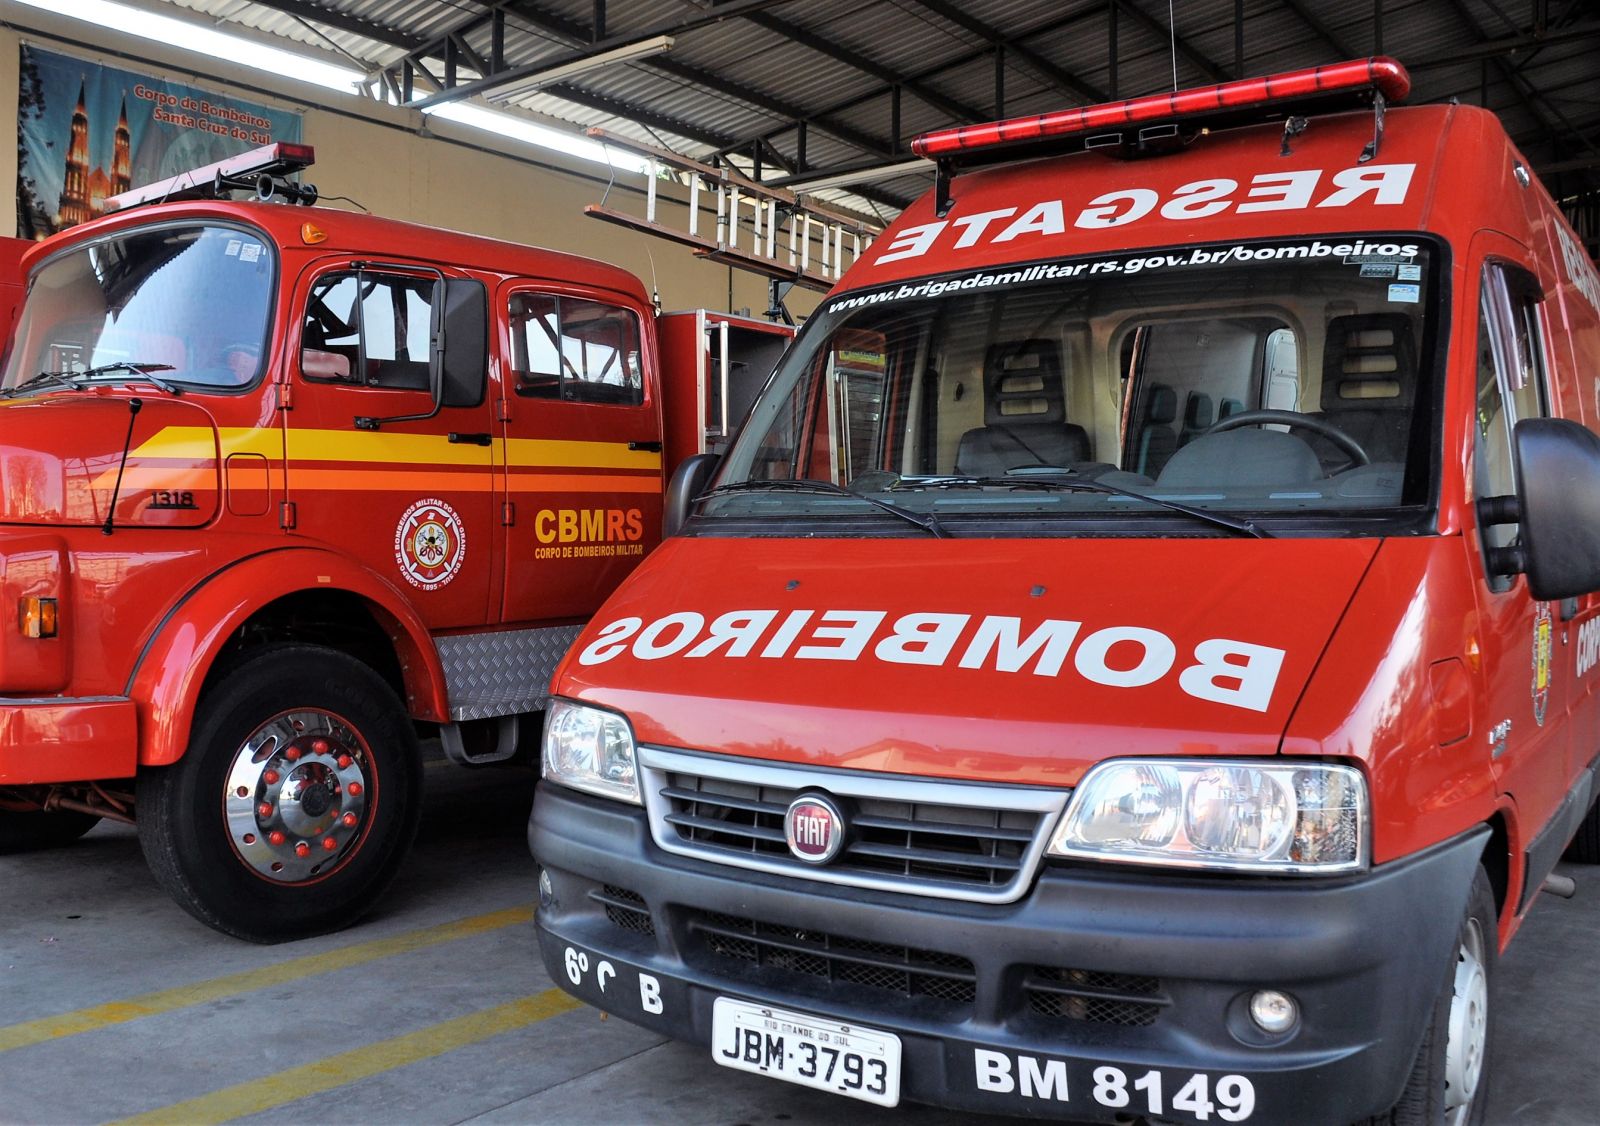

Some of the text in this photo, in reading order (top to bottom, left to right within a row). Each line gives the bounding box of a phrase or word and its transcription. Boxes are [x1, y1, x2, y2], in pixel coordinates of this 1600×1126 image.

[134, 84, 272, 129] Corpo de Bombeiros
[154, 107, 272, 146] Santa Cruz do Sul
[152, 490, 194, 506] 1318
[394, 498, 466, 587] CORPO DE BOMBEIROS MILITAR DO RIO GRANDE DO SUL
[535, 508, 643, 544] CBMRS
[535, 544, 643, 559] CORPO DE BOMBEIROS MILITAR
[422, 583, 438, 591] 1895
[796, 815, 829, 847] FIAT
[639, 972, 664, 1015] B
[764, 1019, 778, 1030] RIO
[781, 1022, 814, 1039] GRANDE
[833, 1034, 851, 1047] SUL
[974, 1048, 1256, 1122] BM 8149
